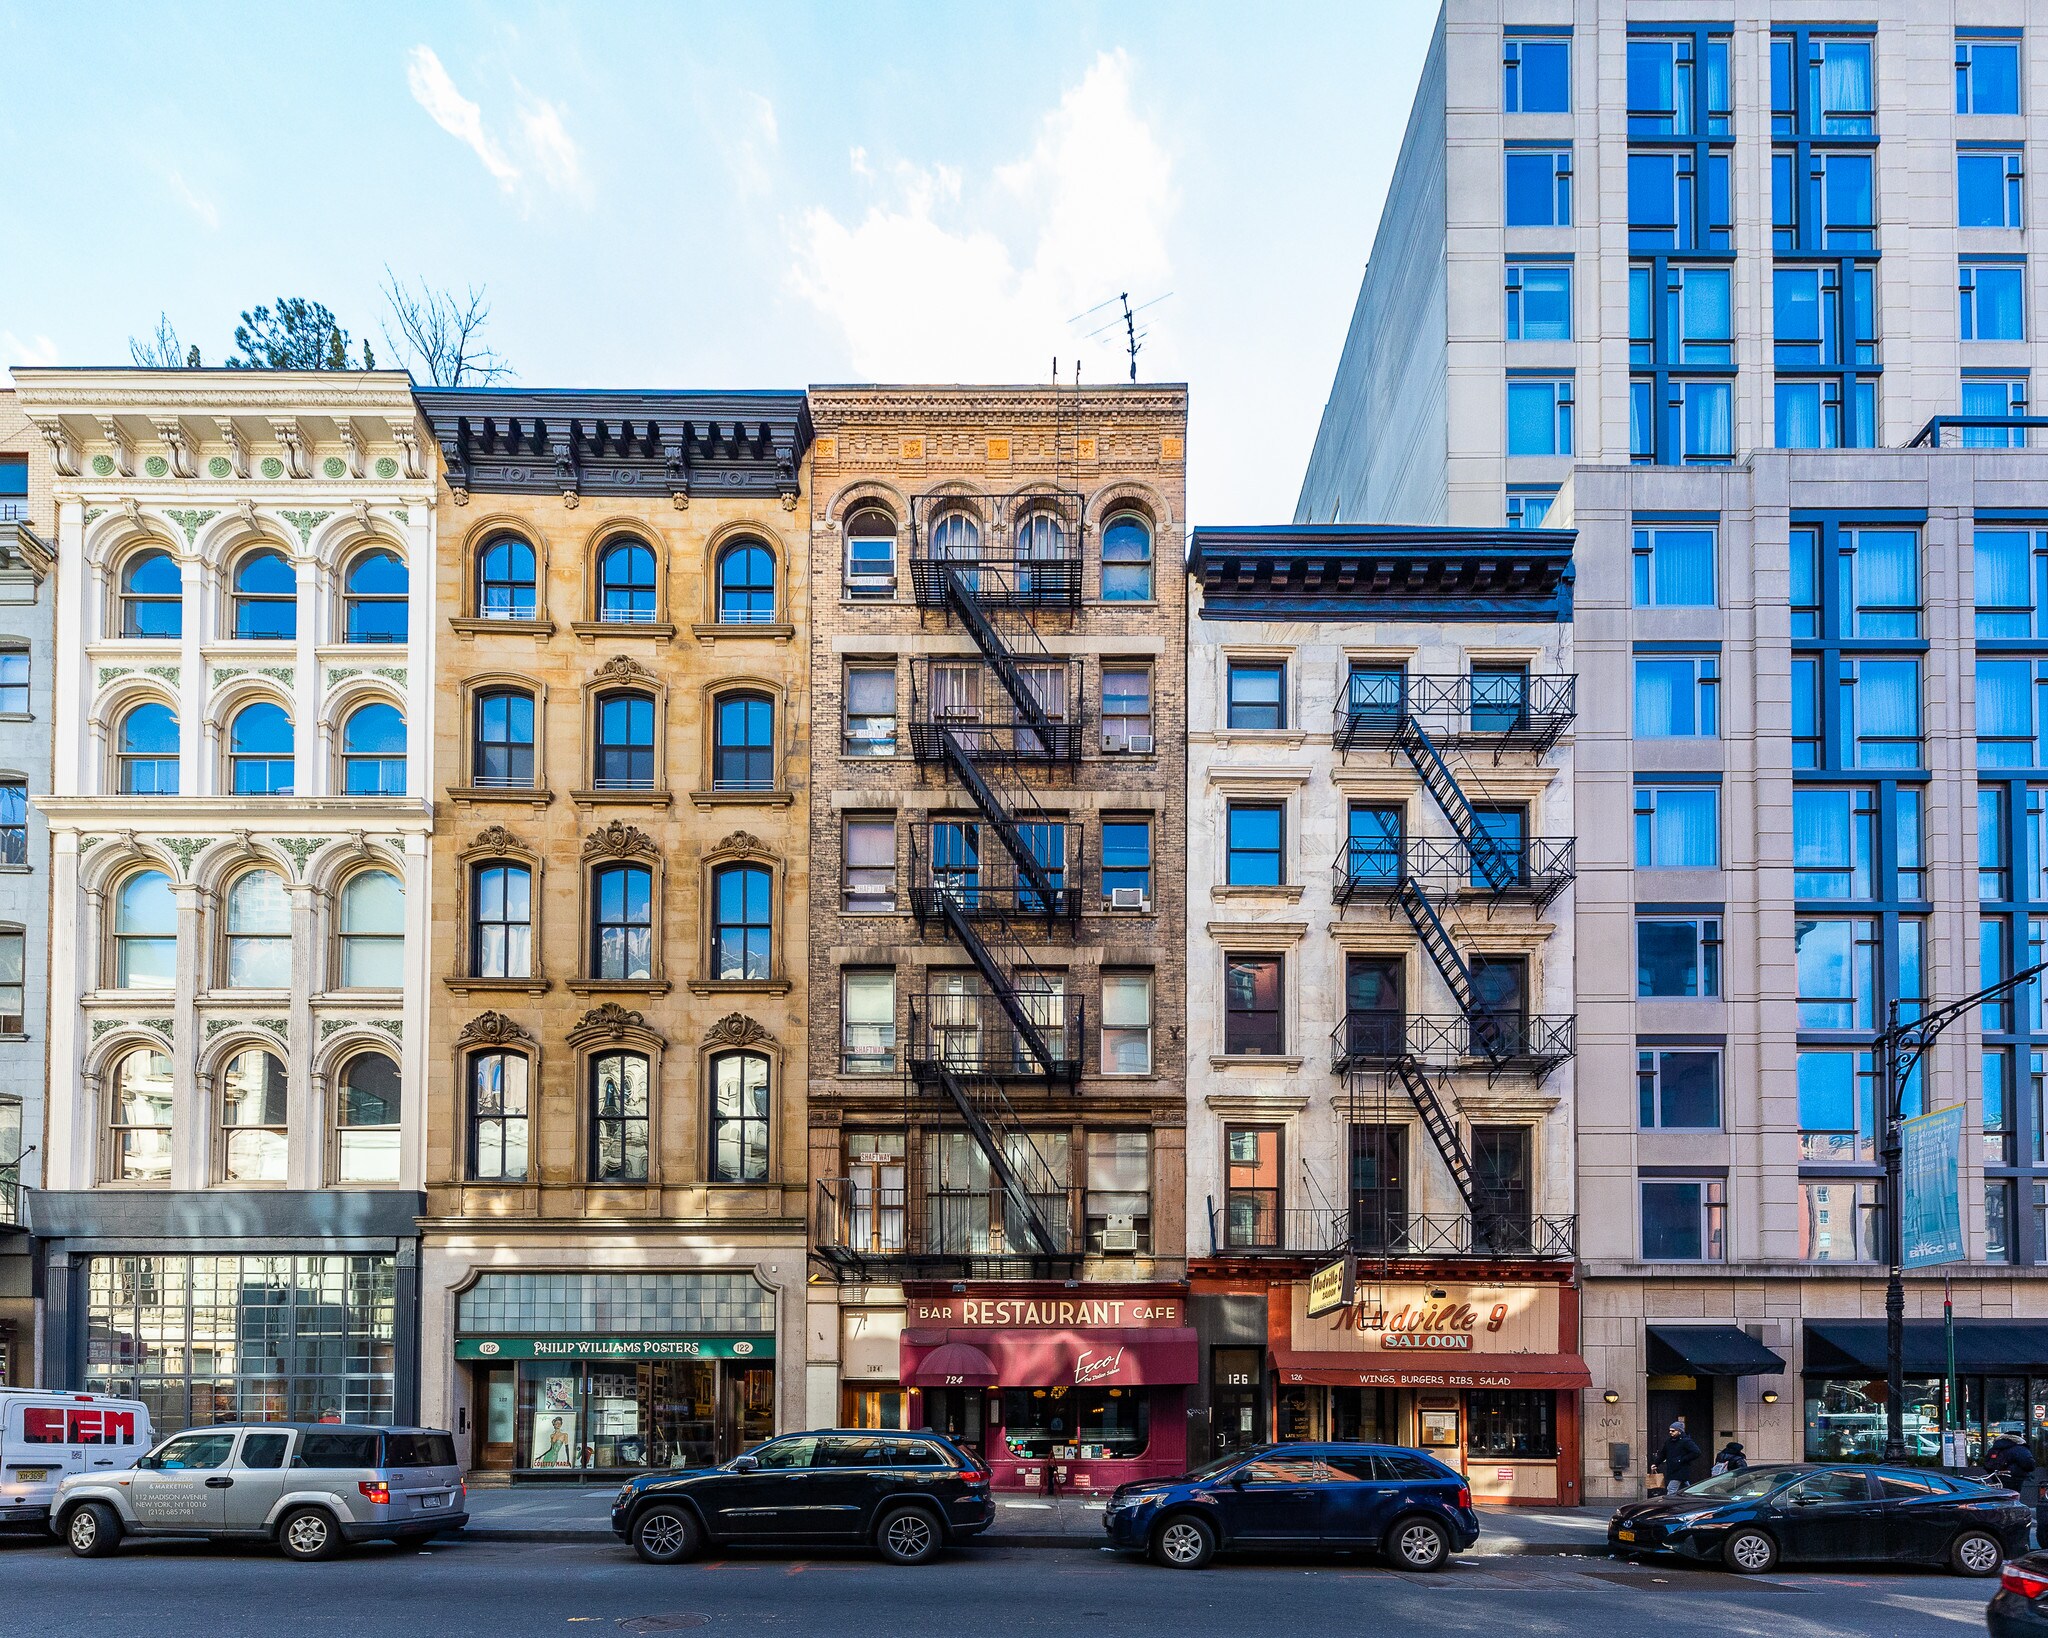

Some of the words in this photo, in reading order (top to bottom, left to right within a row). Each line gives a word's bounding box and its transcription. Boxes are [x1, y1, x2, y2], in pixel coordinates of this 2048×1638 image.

[855, 1046, 885, 1054] SHAFTWAY
[861, 1153, 890, 1161] SHAFTWAY
[920, 1307, 952, 1319] BAR
[963, 1301, 1125, 1325] RESTAURANT
[1132, 1307, 1175, 1319] CAFE
[1330, 1300, 1479, 1332] Mudville
[1486, 1303, 1509, 1333] 9
[1385, 1335, 1469, 1349] SALOON
[482, 1344, 497, 1353] 122
[533, 1341, 575, 1355] PHILIP
[576, 1341, 641, 1354] WILLIAMS
[643, 1341, 700, 1355] POSTERS
[736, 1344, 750, 1353] 122
[1074, 1346, 1124, 1384] Ecco!
[945, 1375, 963, 1385] 124
[1228, 1373, 1249, 1385] 126
[1291, 1373, 1303, 1381] 126
[1360, 1374, 1396, 1385] WINGS,
[1401, 1375, 1444, 1385] BURGERS,
[1449, 1376, 1474, 1386] RIBS,
[1479, 1376, 1511, 1386] SALAD
[1066, 1448, 1074, 1456] A
[148, 1508, 165, 1516] (212)
[166, 1508, 179, 1516] 685
